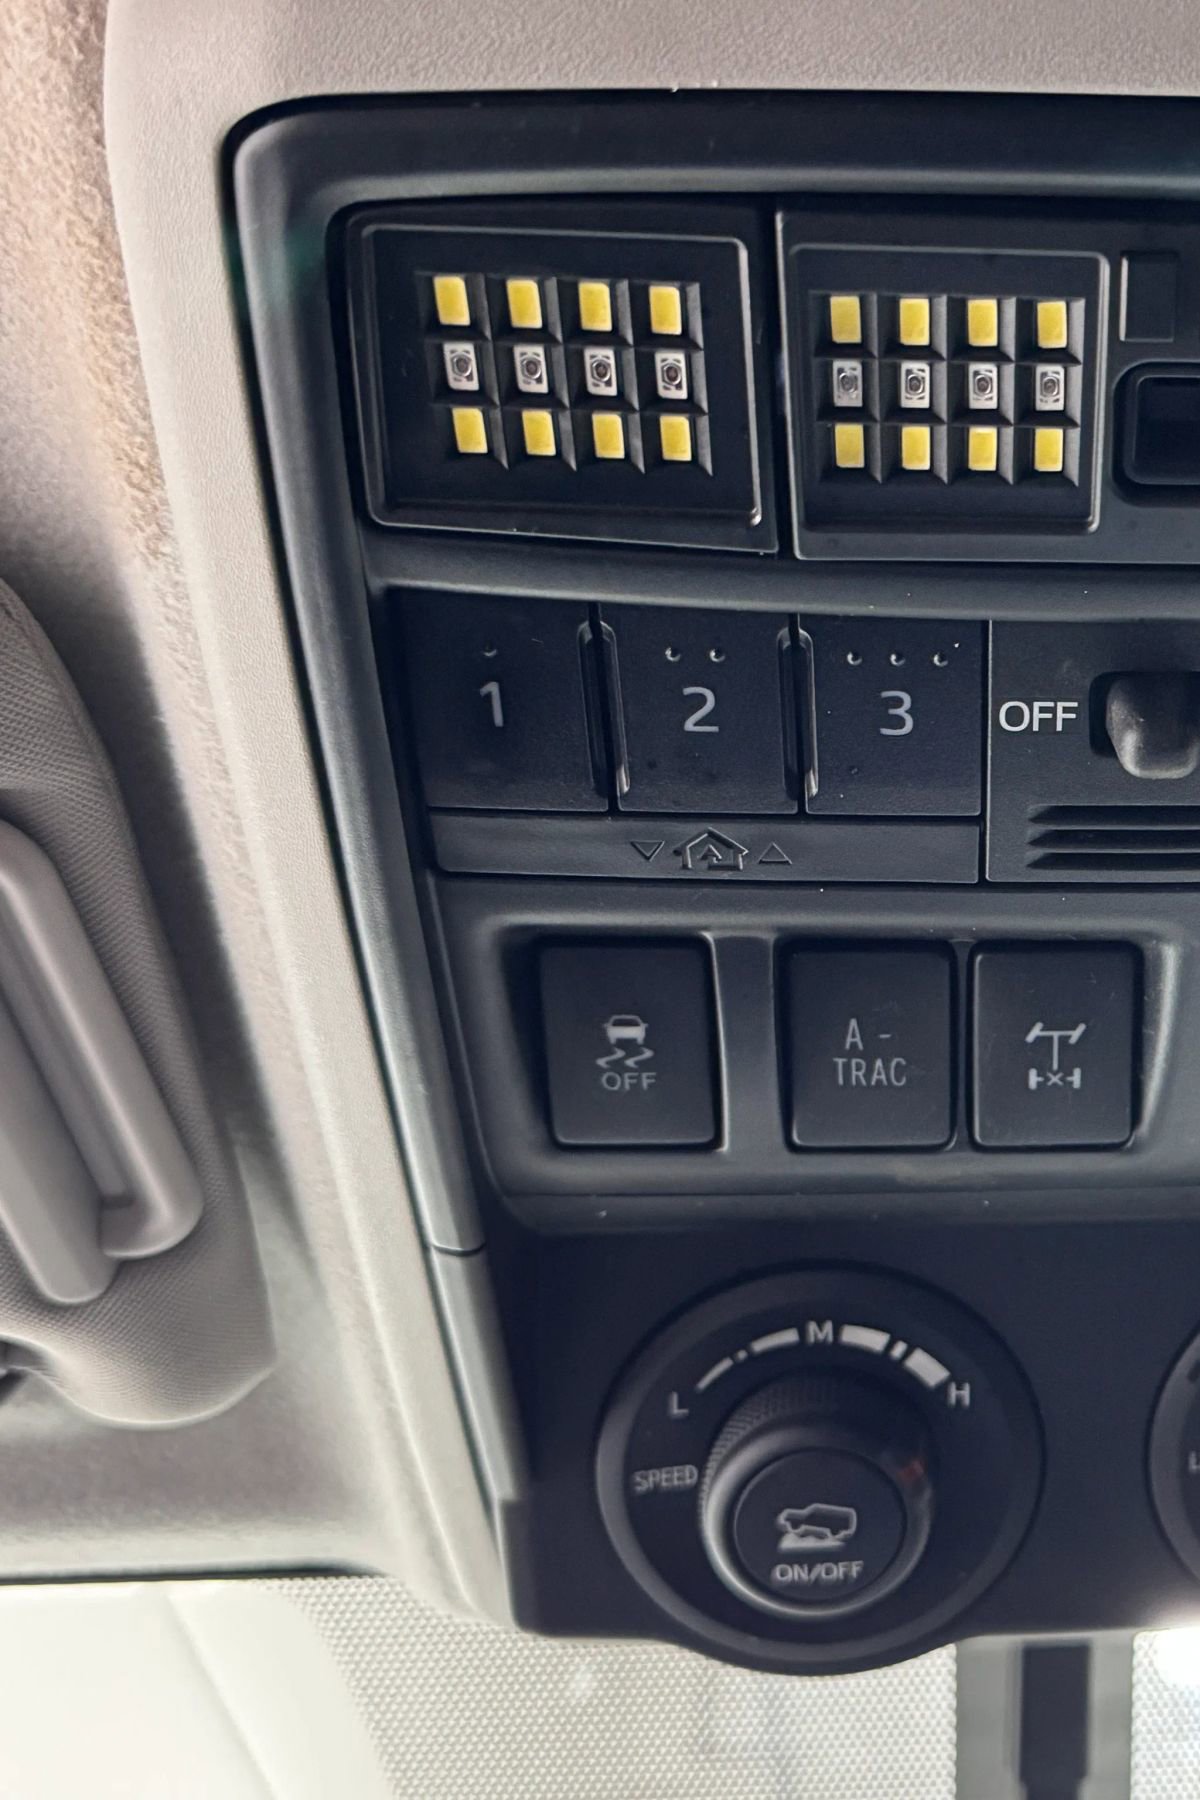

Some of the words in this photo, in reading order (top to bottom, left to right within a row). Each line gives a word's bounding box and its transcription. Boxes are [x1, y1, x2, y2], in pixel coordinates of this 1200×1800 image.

[479, 681, 504, 728] 1
[682, 686, 720, 733] 2
[879, 690, 914, 736] 3
[998, 701, 1079, 733] OFF
[845, 1017, 864, 1050] A
[601, 1070, 657, 1092] OFF
[832, 1056, 908, 1087] TRAC
[807, 1321, 834, 1344] M
[670, 1391, 689, 1417] L
[948, 1383, 971, 1407] H
[634, 1465, 698, 1494] SPEED
[772, 1559, 865, 1584] ON/OFF
